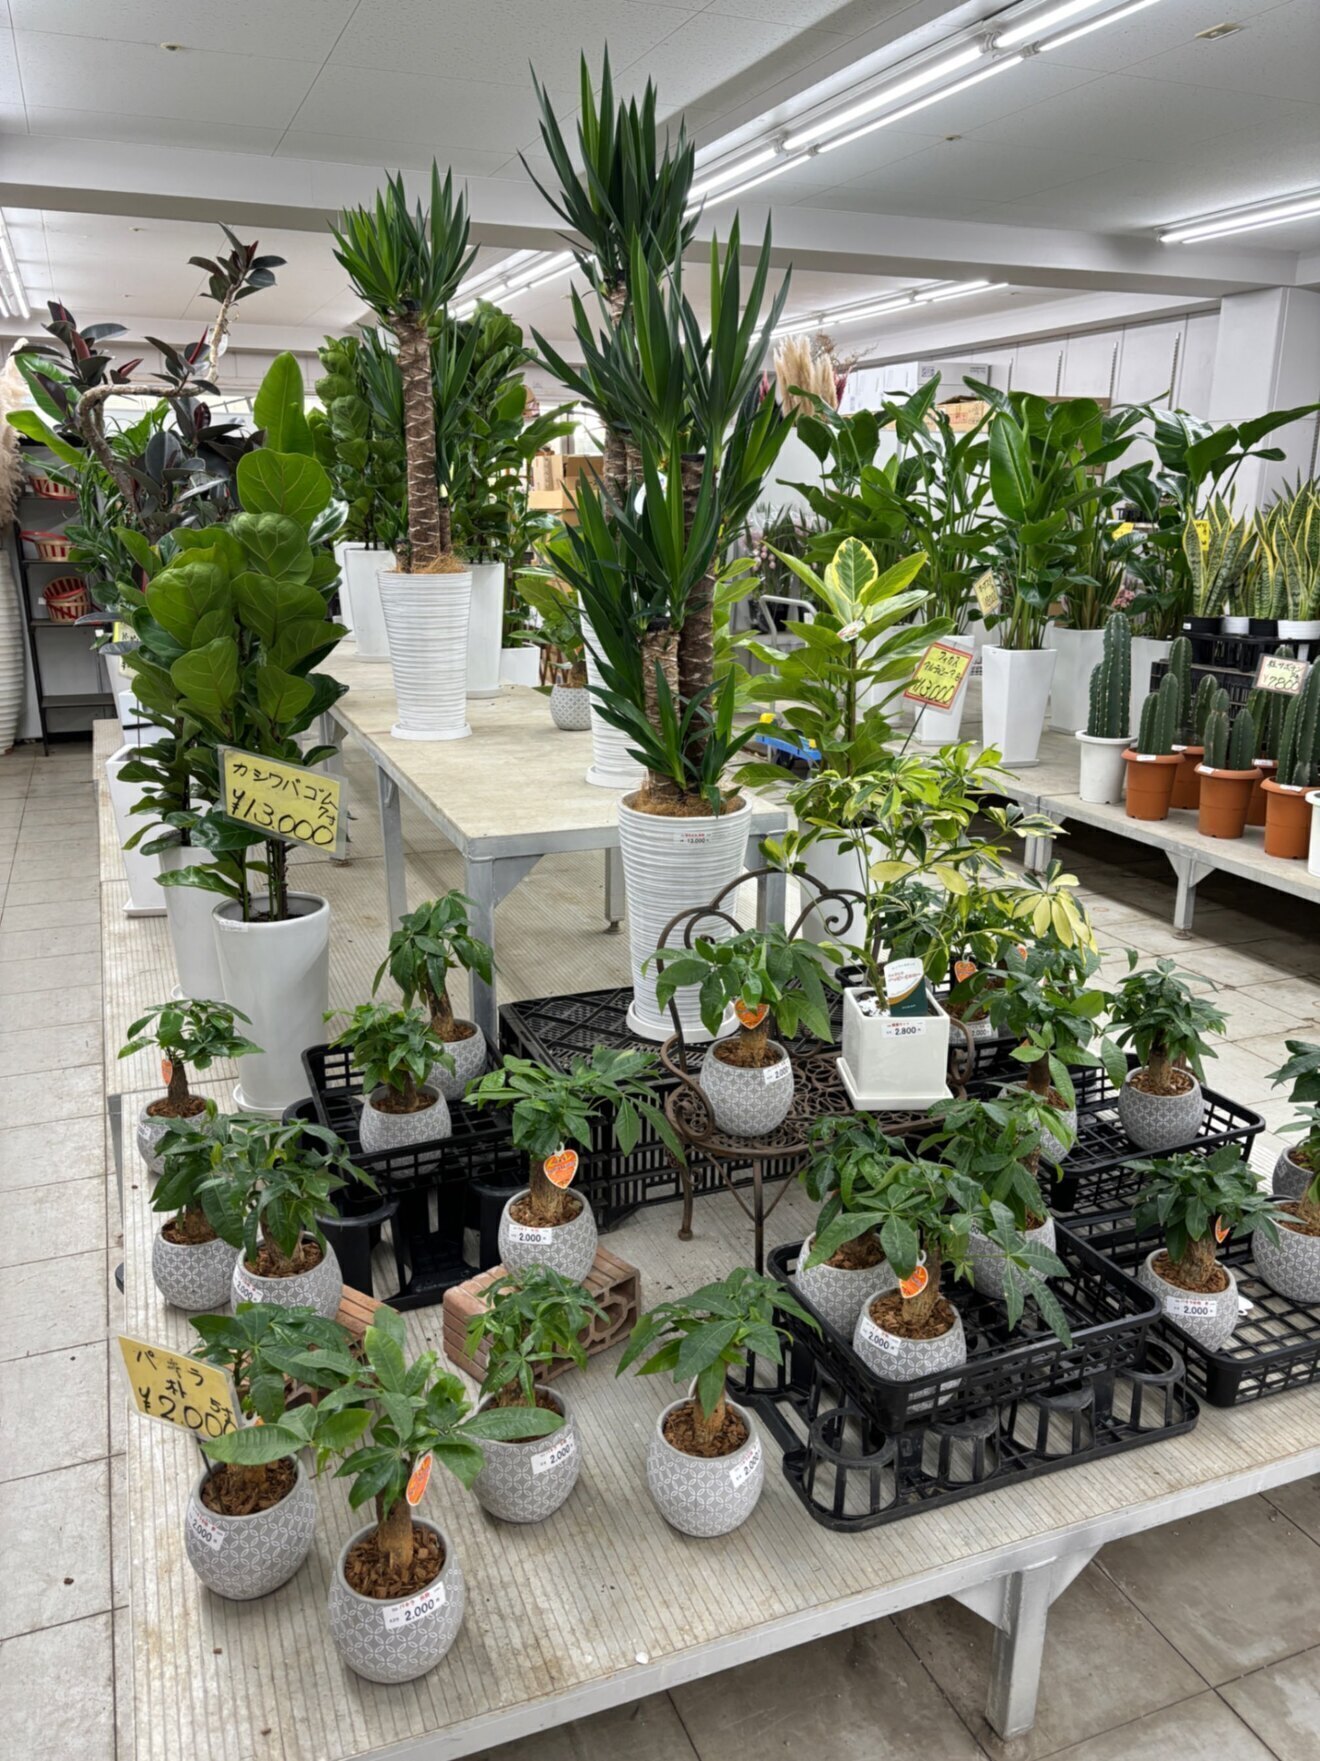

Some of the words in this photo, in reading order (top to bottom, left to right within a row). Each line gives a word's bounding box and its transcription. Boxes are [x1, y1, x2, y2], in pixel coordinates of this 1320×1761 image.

[232, 762, 338, 810] カシワバゴム
[519, 1232, 542, 1242] 2.000
[1183, 1305, 1208, 1315] 2.000
[135, 1349, 205, 1387] パキラ
[404, 1599, 435, 1621] 2.000
